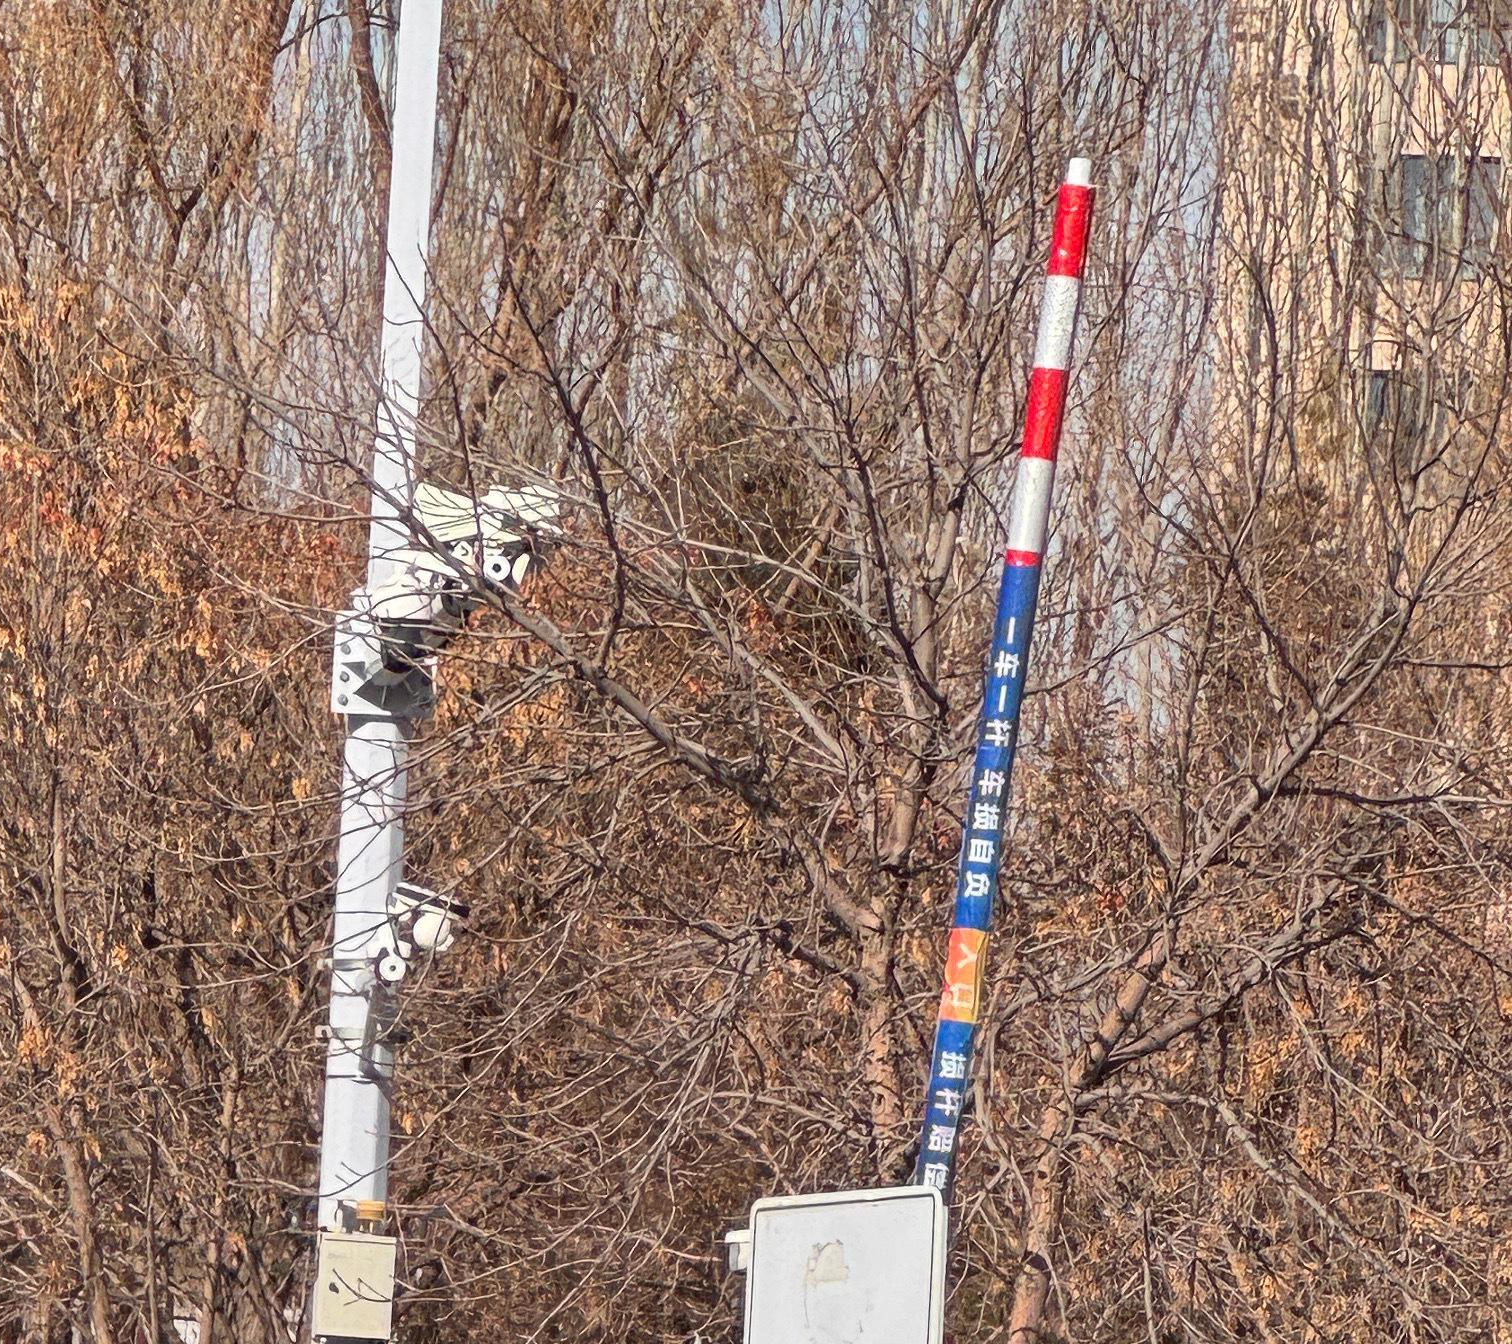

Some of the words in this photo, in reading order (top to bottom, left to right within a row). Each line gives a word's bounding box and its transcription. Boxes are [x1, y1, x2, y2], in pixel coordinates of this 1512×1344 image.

[985, 616, 1020, 747] 一车一杆
[964, 769, 1005, 898] 车损自负
[950, 943, 977, 1010] 入口
